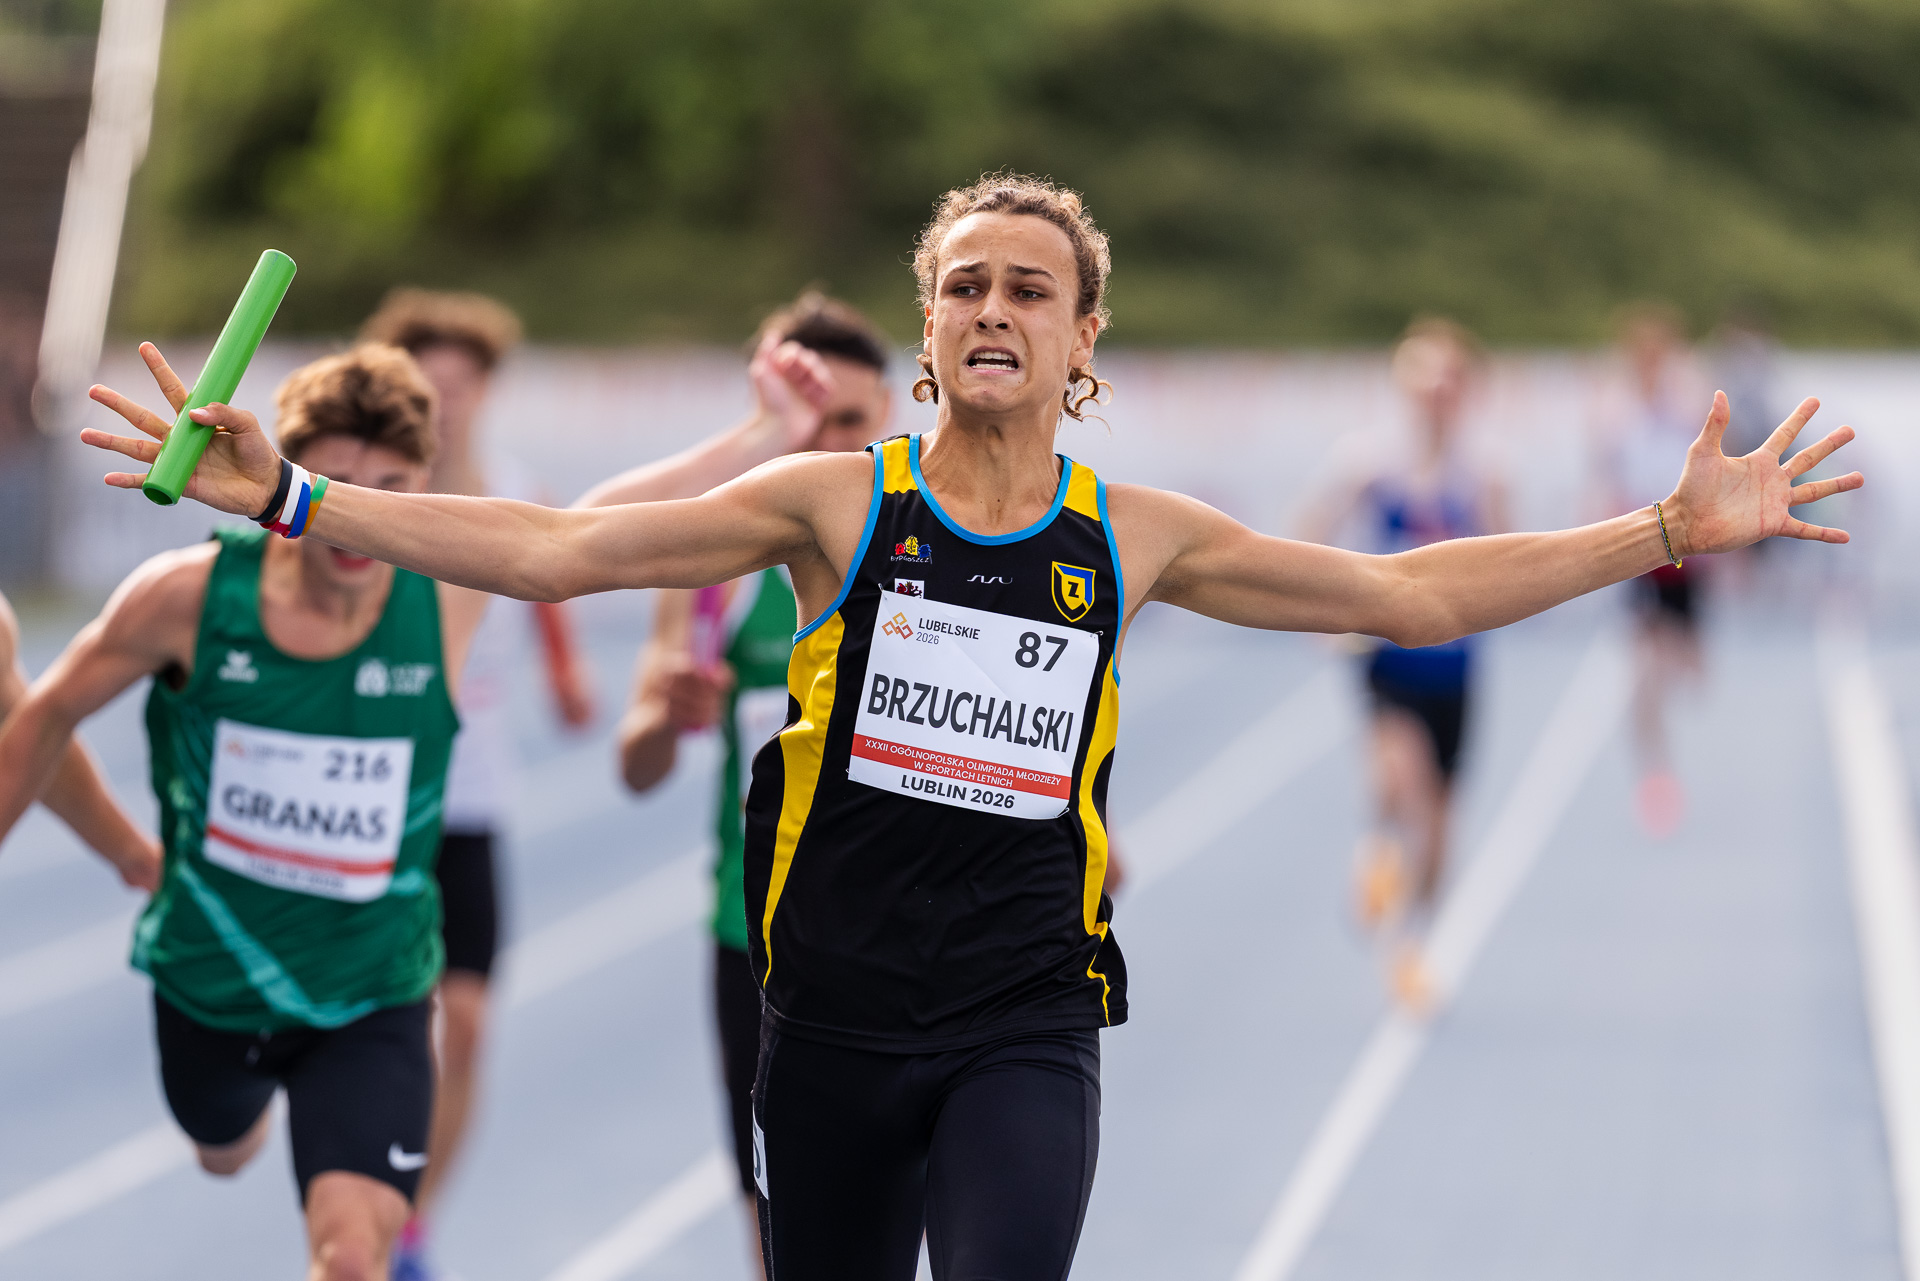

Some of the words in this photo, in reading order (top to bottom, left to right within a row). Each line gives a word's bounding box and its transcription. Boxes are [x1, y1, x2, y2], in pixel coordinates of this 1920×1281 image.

[1067, 581, 1080, 599] Z
[916, 632, 940, 645] 2026
[918, 617, 980, 640] LUBELSKIE
[1015, 631, 1069, 672] 87
[867, 673, 1074, 753] BRZUCHALSKI
[325, 750, 392, 780] 216
[865, 739, 889, 752] XXXII
[890, 744, 965, 768] OGÓLNOPOLSKA
[966, 760, 1014, 778] OLIMPIADA
[1015, 770, 1062, 786] MŁODZIEŻY
[913, 761, 924, 770] W
[925, 763, 976, 782] SPORTACH
[977, 773, 1013, 788] LETNICH
[901, 774, 967, 801] LUBLIN
[970, 788, 1015, 809] 2026
[222, 784, 387, 842] GRANAS
